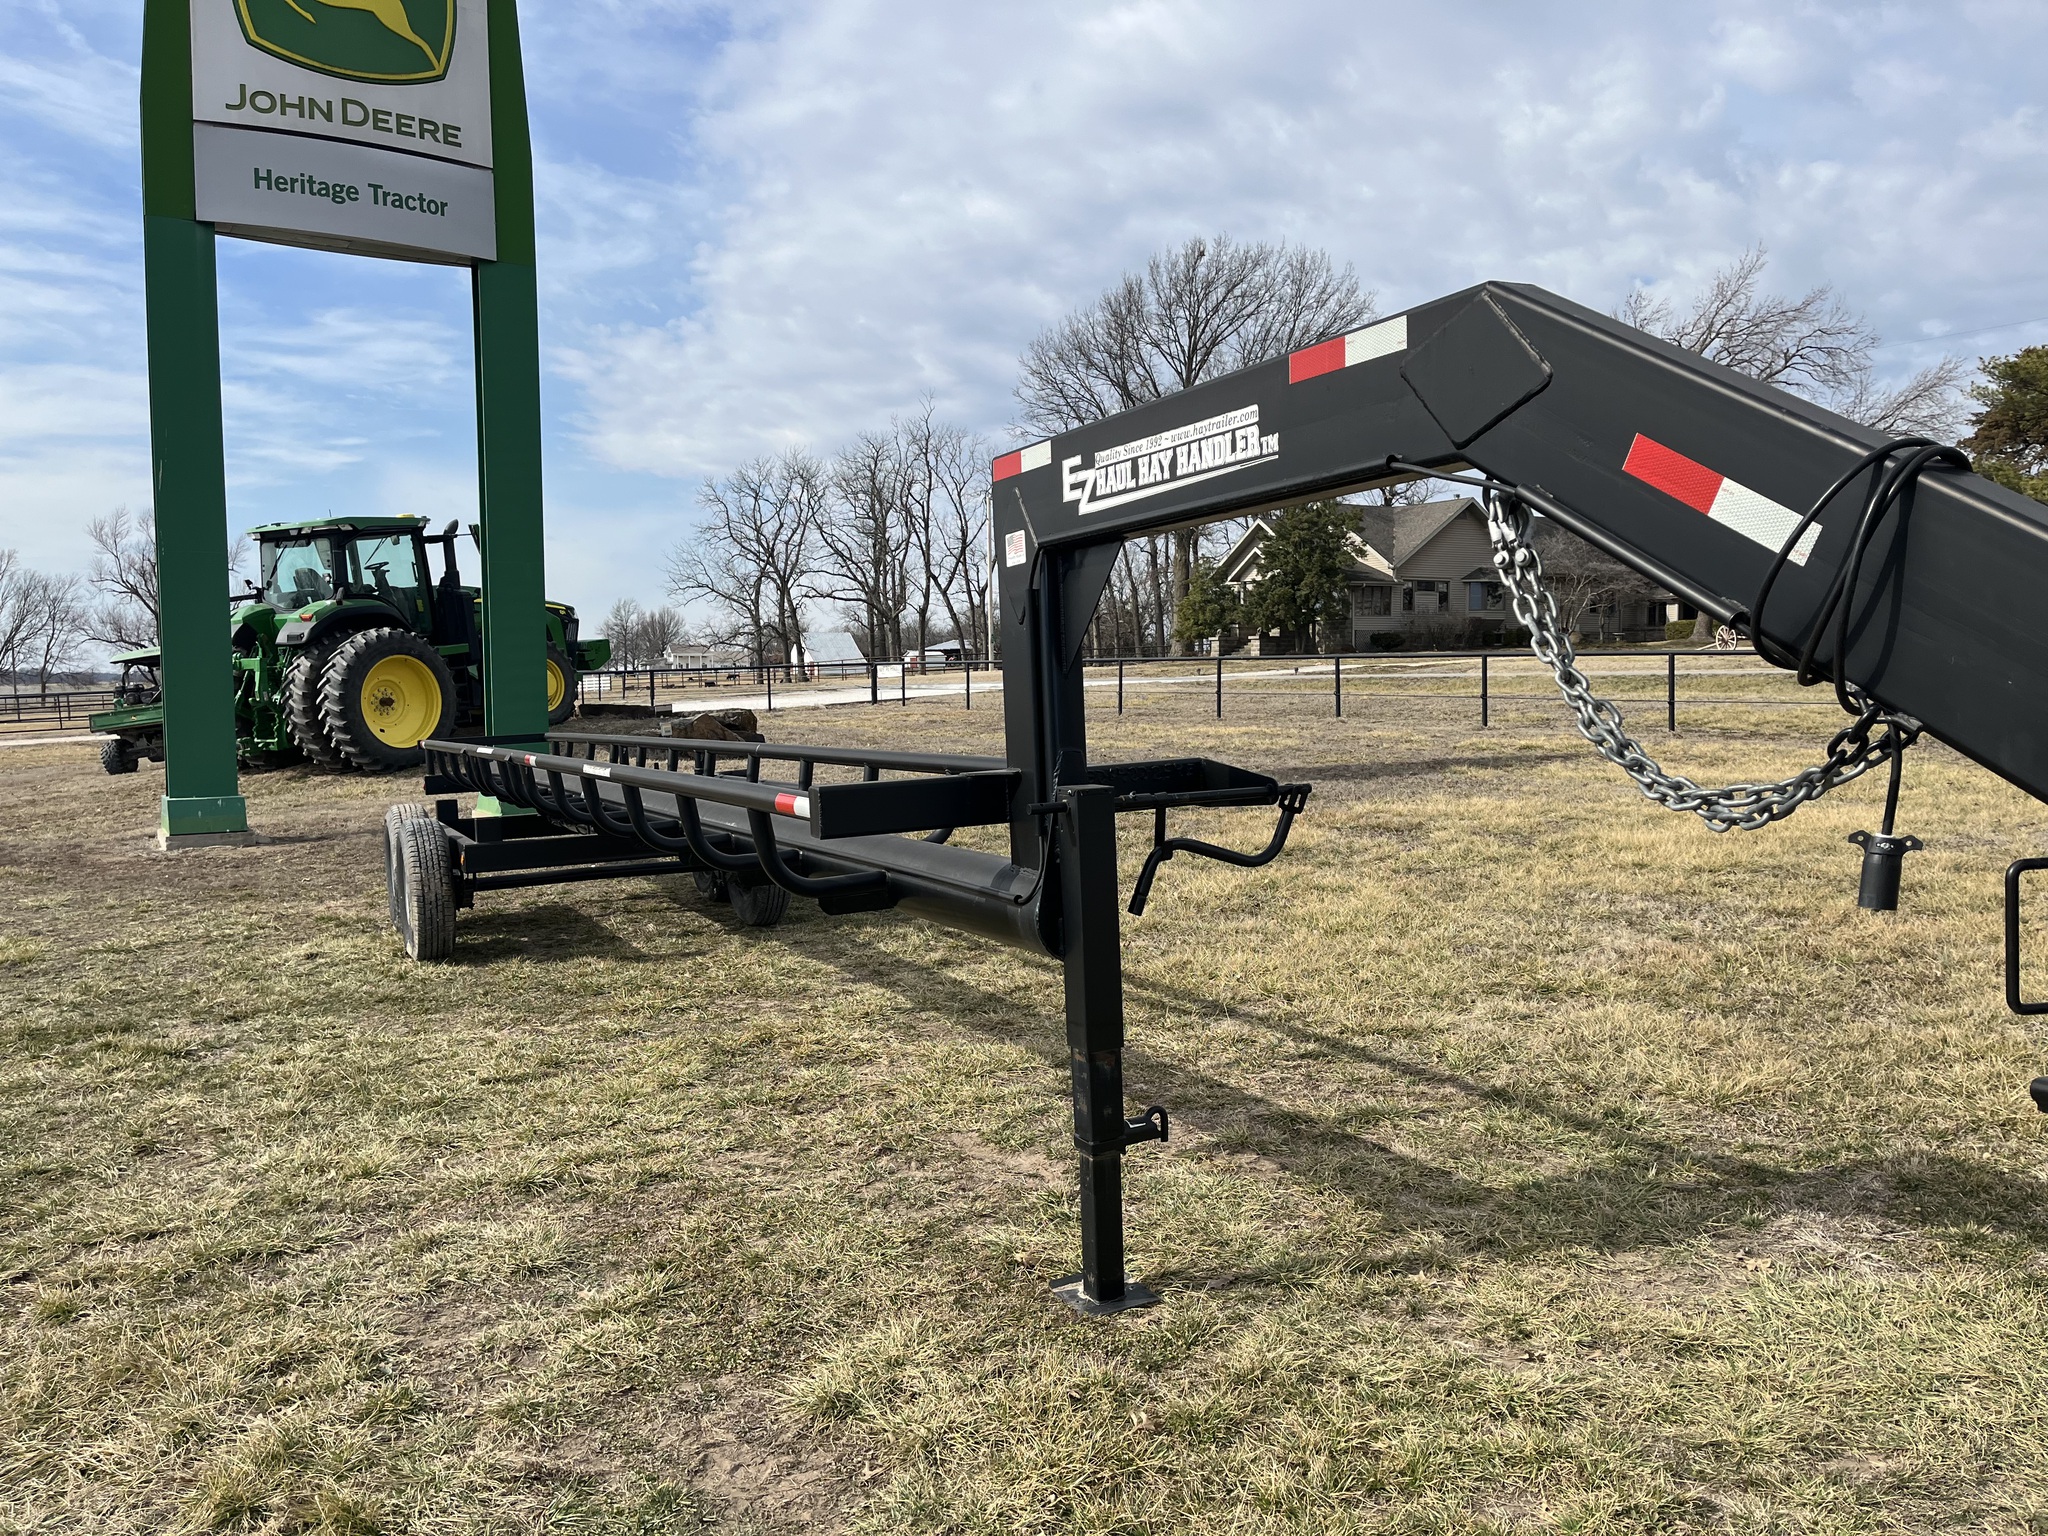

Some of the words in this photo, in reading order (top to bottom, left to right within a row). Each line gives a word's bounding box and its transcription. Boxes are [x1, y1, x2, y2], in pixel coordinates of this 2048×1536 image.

[225, 84, 333, 123] JOHN
[341, 97, 462, 148] DEERE
[253, 167, 360, 205] Heritage
[367, 182, 448, 217] Tractor
[1095, 449, 1121, 466] Quality
[1123, 443, 1144, 457] Since
[1146, 434, 1163, 450] 1992
[1171, 409, 1258, 443] www.haytrailer.com
[1062, 453, 1097, 516] EZ
[1096, 459, 1137, 497] HAUL
[1138, 447, 1174, 487] HAY
[1176, 424, 1261, 477] HANDLER
[1260, 432, 1279, 456] TM
